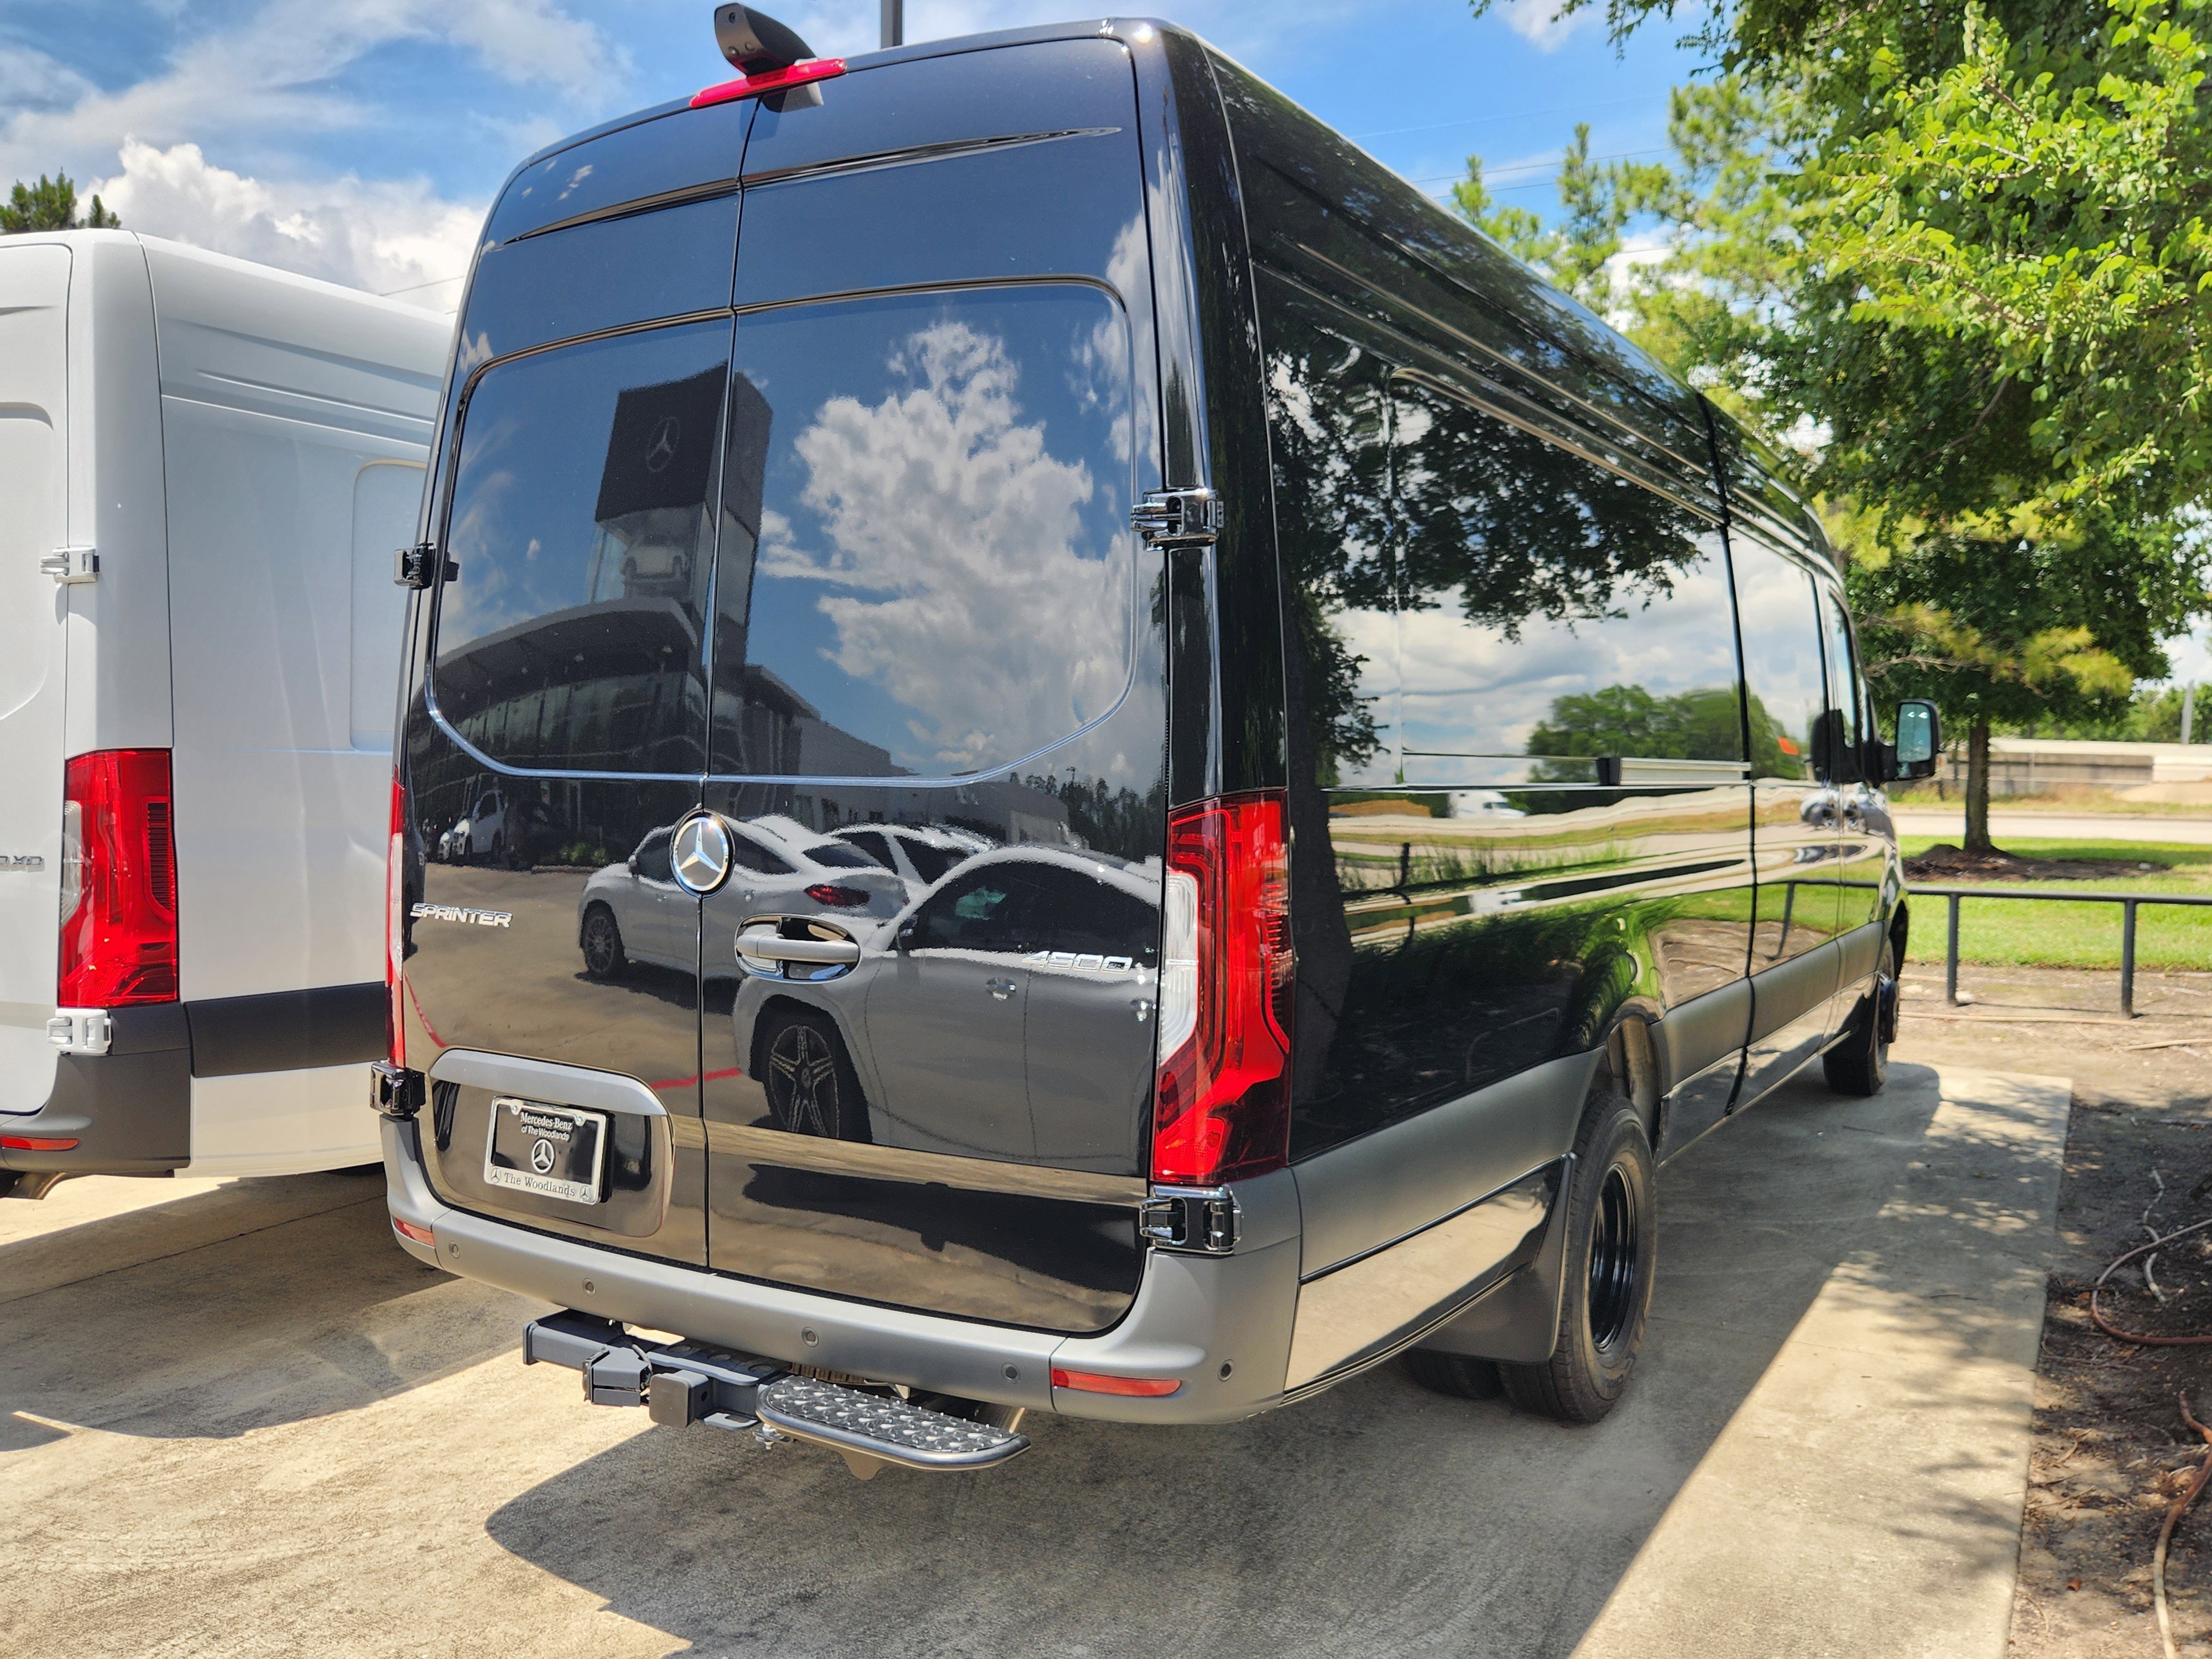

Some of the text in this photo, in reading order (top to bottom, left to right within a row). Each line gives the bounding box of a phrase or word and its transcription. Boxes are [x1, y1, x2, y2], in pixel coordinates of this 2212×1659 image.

[410, 902, 512, 928] SPRINTER
[1022, 951, 1133, 974] 4500
[520, 1112, 573, 1130] Mercedes-Benz
[521, 1125, 570, 1141] of The Woodlands
[504, 1172, 575, 1196] The Woodlands
